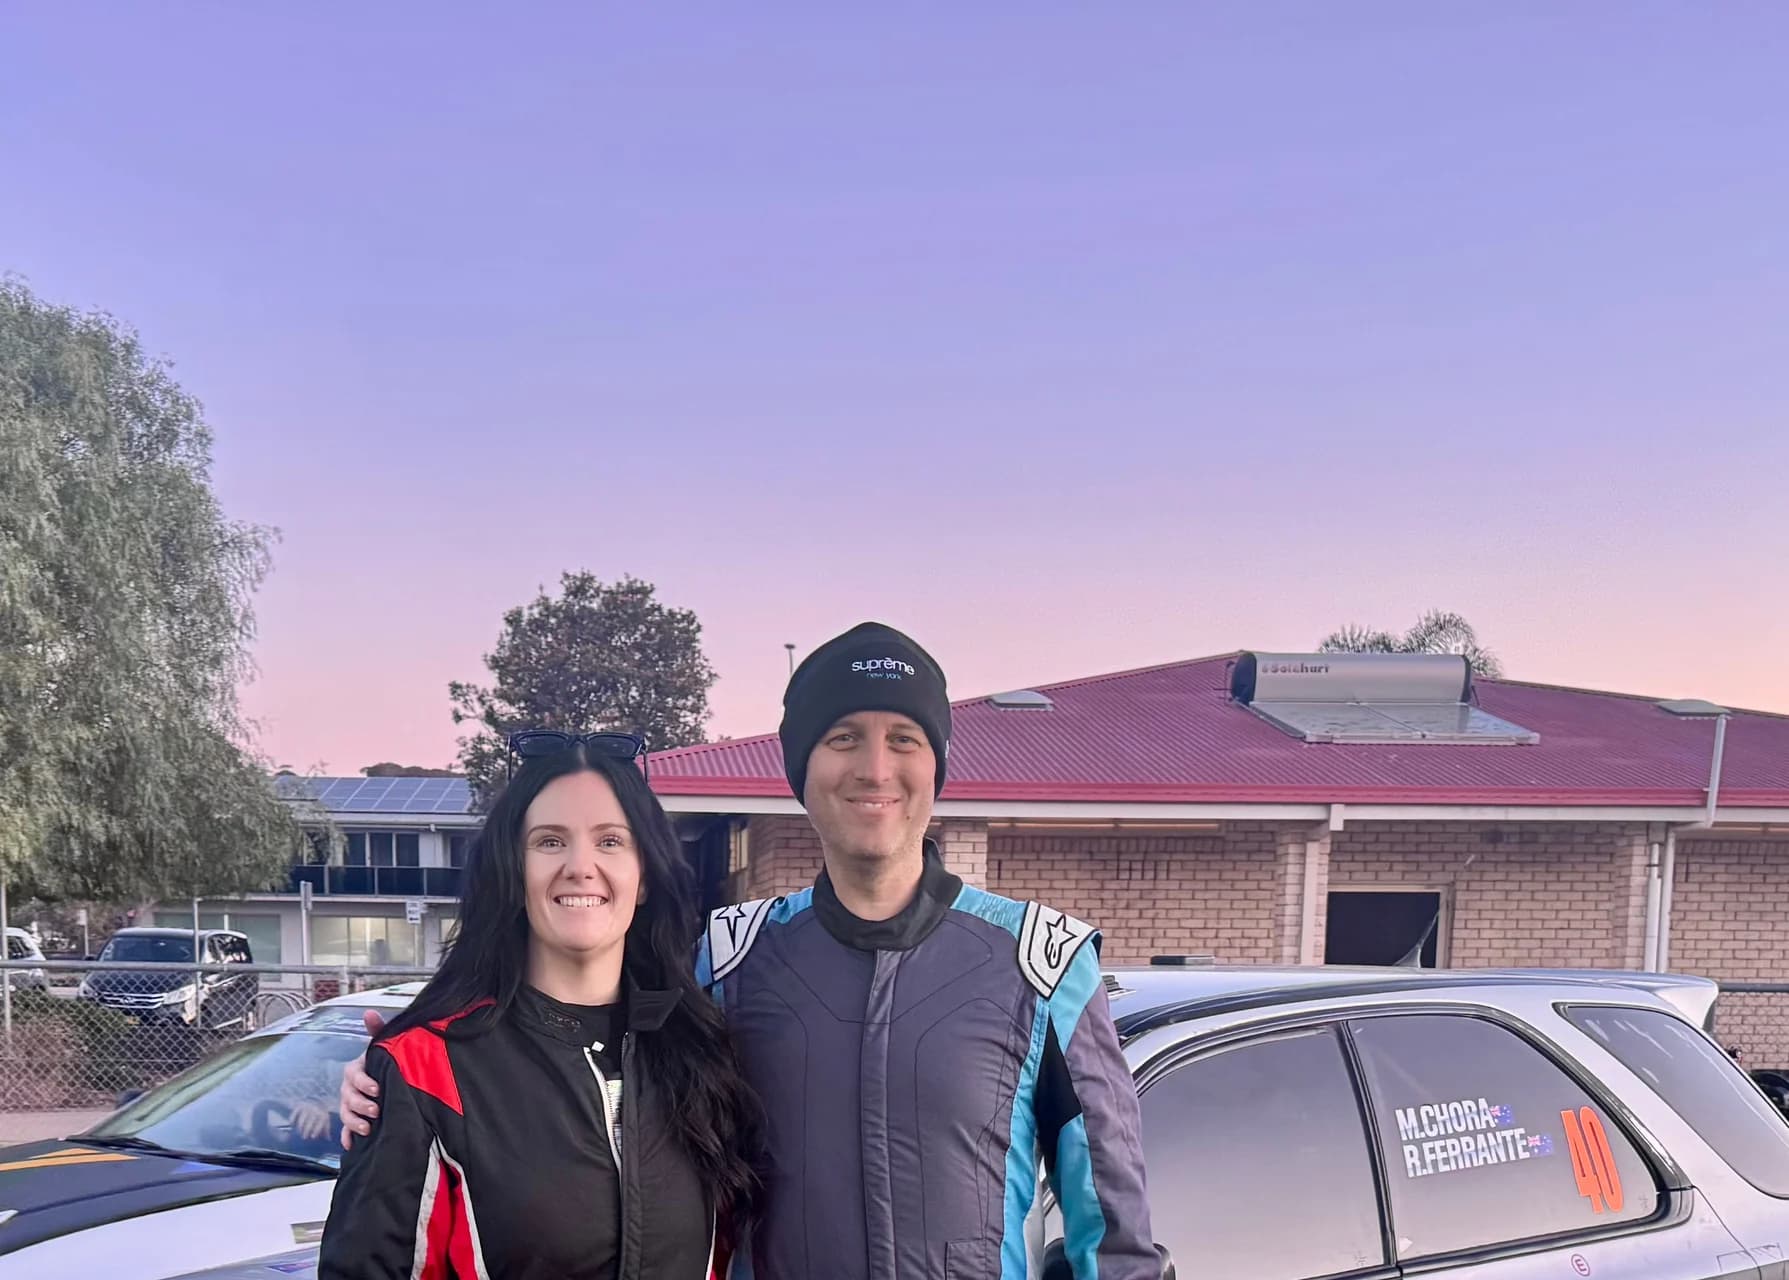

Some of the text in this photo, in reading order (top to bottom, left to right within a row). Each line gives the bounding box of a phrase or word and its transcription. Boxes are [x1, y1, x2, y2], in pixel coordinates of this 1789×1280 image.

[1395, 1098, 1496, 1141] M.CHORA
[1403, 1128, 1530, 1178] R.FERRANTE
[1560, 1105, 1624, 1215] 40
